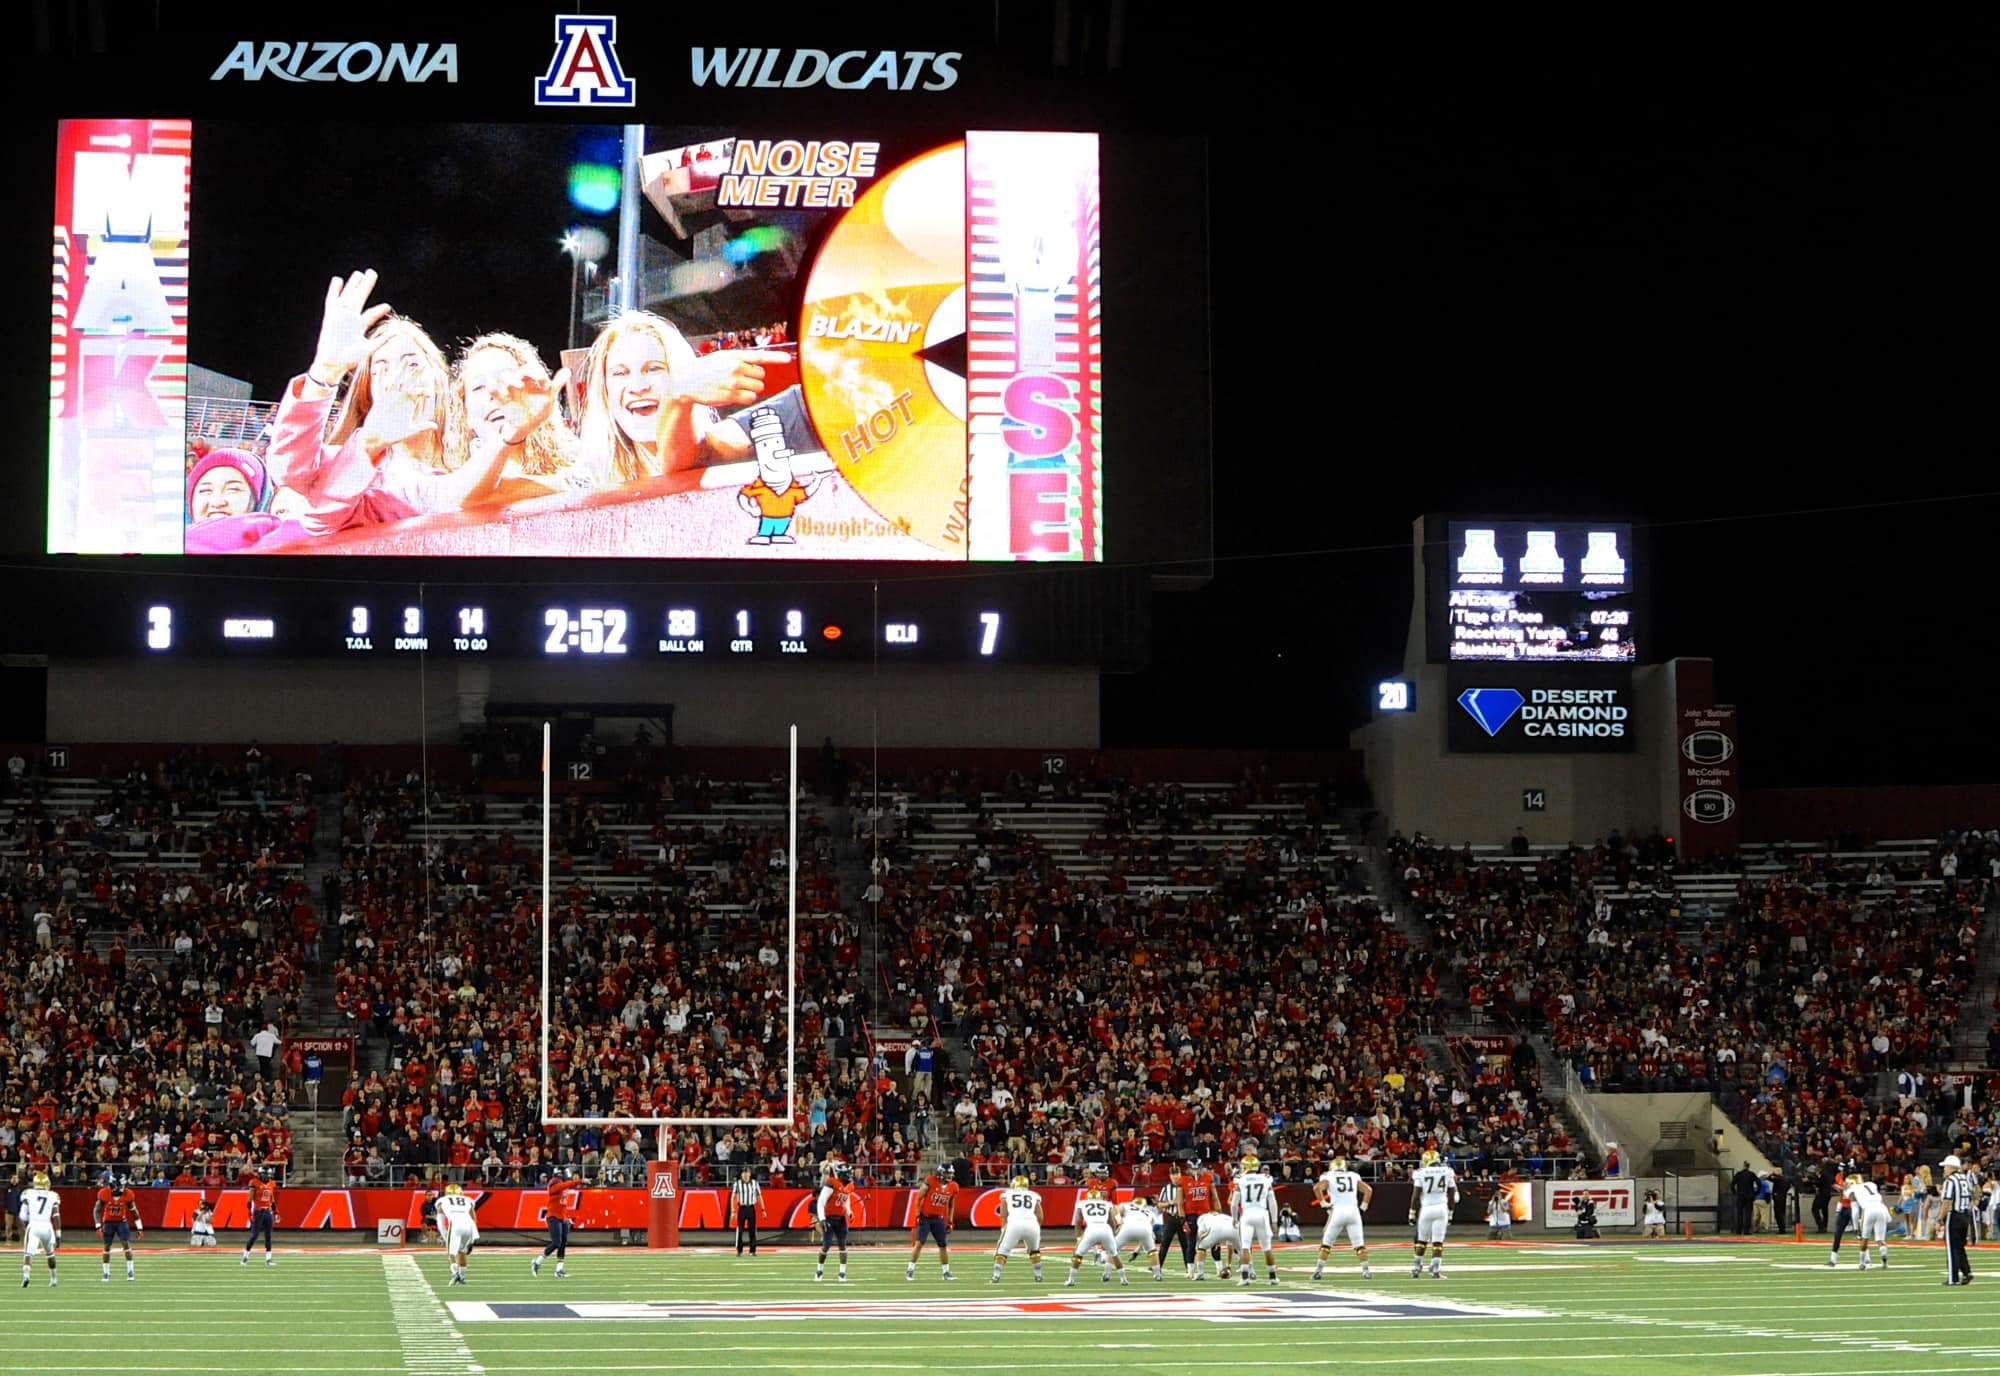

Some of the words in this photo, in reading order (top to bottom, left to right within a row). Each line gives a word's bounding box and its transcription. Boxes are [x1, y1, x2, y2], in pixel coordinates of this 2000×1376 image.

[210, 41, 458, 82] ARIZONA
[535, 15, 636, 107] A
[691, 47, 961, 91] WILDCATS
[732, 140, 880, 177] NOISE
[717, 175, 857, 207] METER
[808, 316, 922, 344] BLAZIN'
[840, 391, 915, 463] HOT
[149, 606, 171, 648] 3
[352, 607, 368, 634] 3
[404, 607, 420, 634] 3
[458, 608, 485, 635] 14
[736, 611, 749, 637] 1
[786, 611, 802, 637] 3
[544, 608, 628, 654] 2:52
[980, 613, 1000, 654] 7
[394, 638, 428, 650] DOWN
[453, 639, 469, 650] TO
[471, 639, 488, 650] GO
[659, 640, 686, 652] BALL
[687, 640, 704, 652] ON
[730, 640, 753, 652] QTR
[1380, 683, 1407, 708] 20
[1531, 689, 1617, 704] DESERT
[1521, 706, 1628, 720] DIAMOND
[1524, 722, 1625, 737] CASINOS
[49, 751, 67, 767] 11
[1045, 757, 1064, 774] 13
[570, 763, 590, 779] 12
[1525, 792, 1545, 808] 14
[1703, 803, 1716, 811] 90
[650, 1173, 676, 1198] A
[1245, 1183, 1265, 1203] 17
[1335, 1176, 1354, 1193] 51
[1423, 1175, 1447, 1194] 74
[1863, 1184, 1876, 1196] 1
[37, 1196, 48, 1215] 7
[448, 1196, 466, 1207] 18
[1011, 1193, 1033, 1210] 56
[1551, 1188, 1630, 1210] ESPN
[1085, 1202, 1107, 1217] 25
